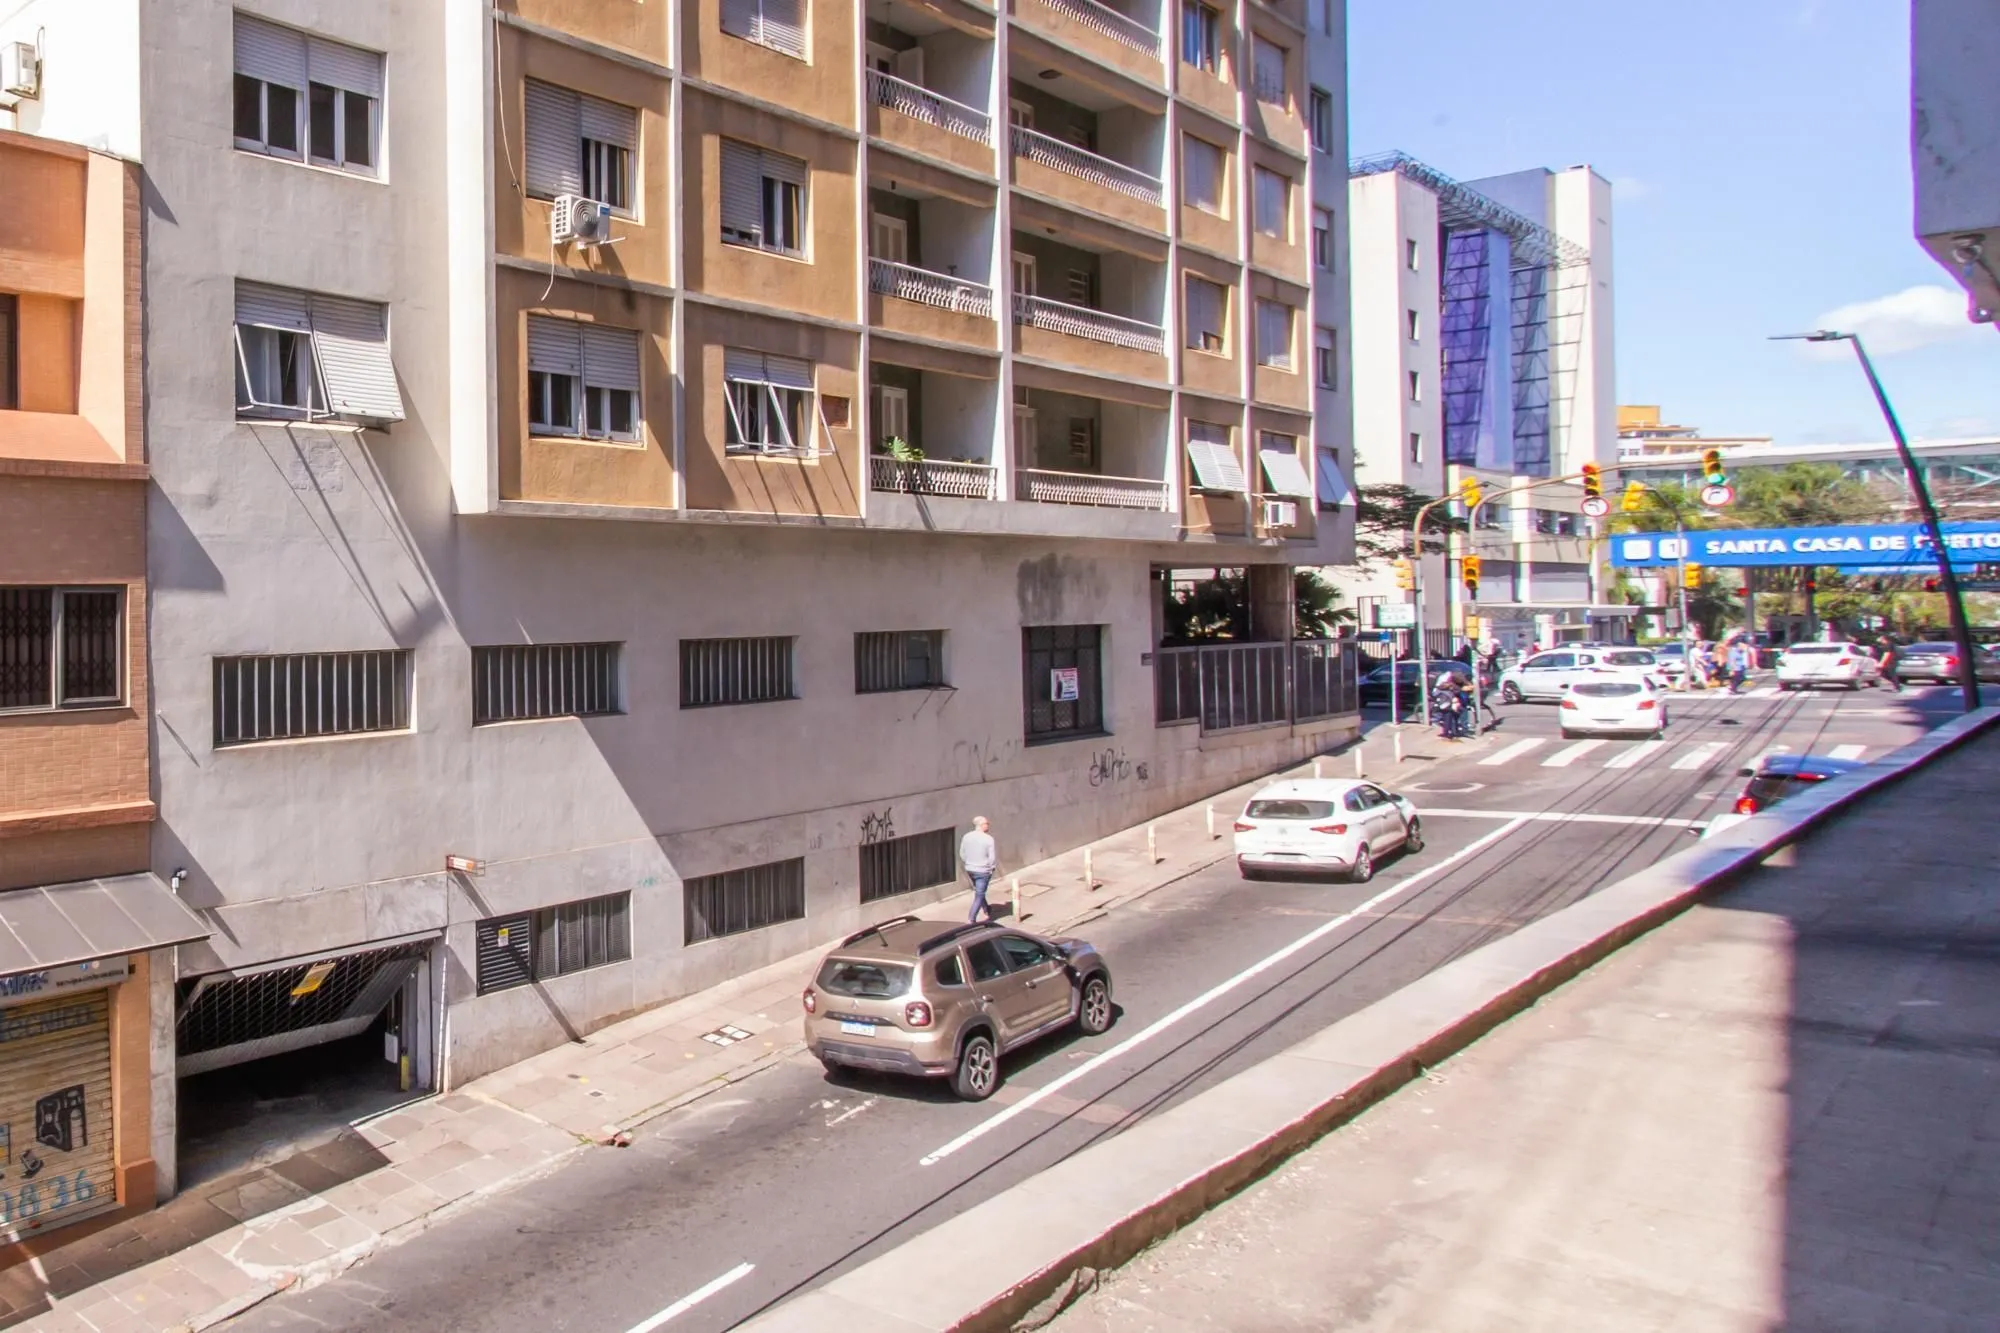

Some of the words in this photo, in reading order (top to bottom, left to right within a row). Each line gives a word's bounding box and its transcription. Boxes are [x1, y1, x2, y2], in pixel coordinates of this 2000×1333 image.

[1706, 539, 1787, 555] SANTA
[1793, 537, 1864, 552] CASA
[1870, 535, 1907, 551] DE
